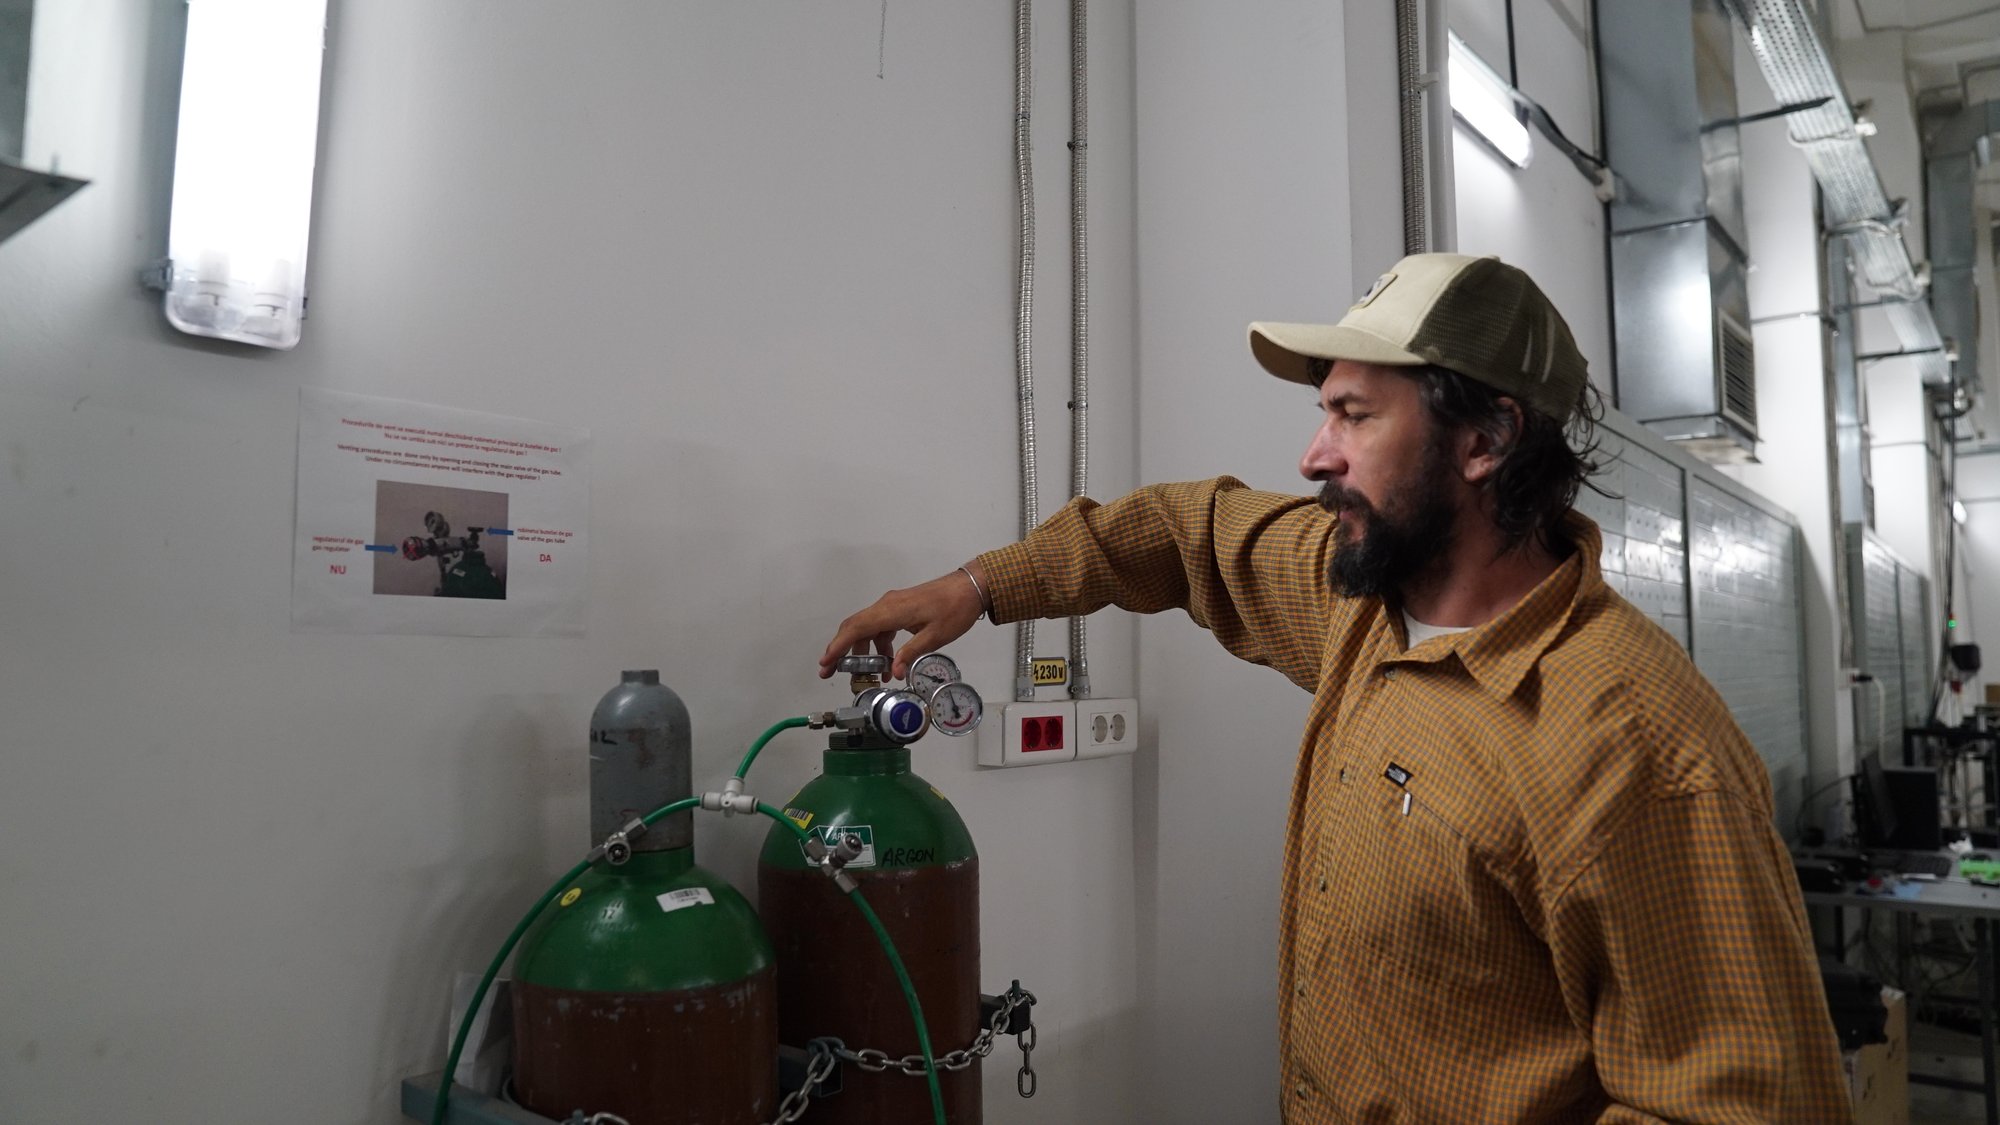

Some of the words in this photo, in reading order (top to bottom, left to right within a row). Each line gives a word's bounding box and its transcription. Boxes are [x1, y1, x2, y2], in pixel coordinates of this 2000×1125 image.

[361, 447, 392, 456] procedures
[440, 456, 460, 465] opening
[472, 460, 490, 468] closing
[392, 459, 430, 468] circumstances
[540, 554, 552, 562] DA
[330, 564, 346, 575] NU
[882, 848, 934, 868] ARGON
